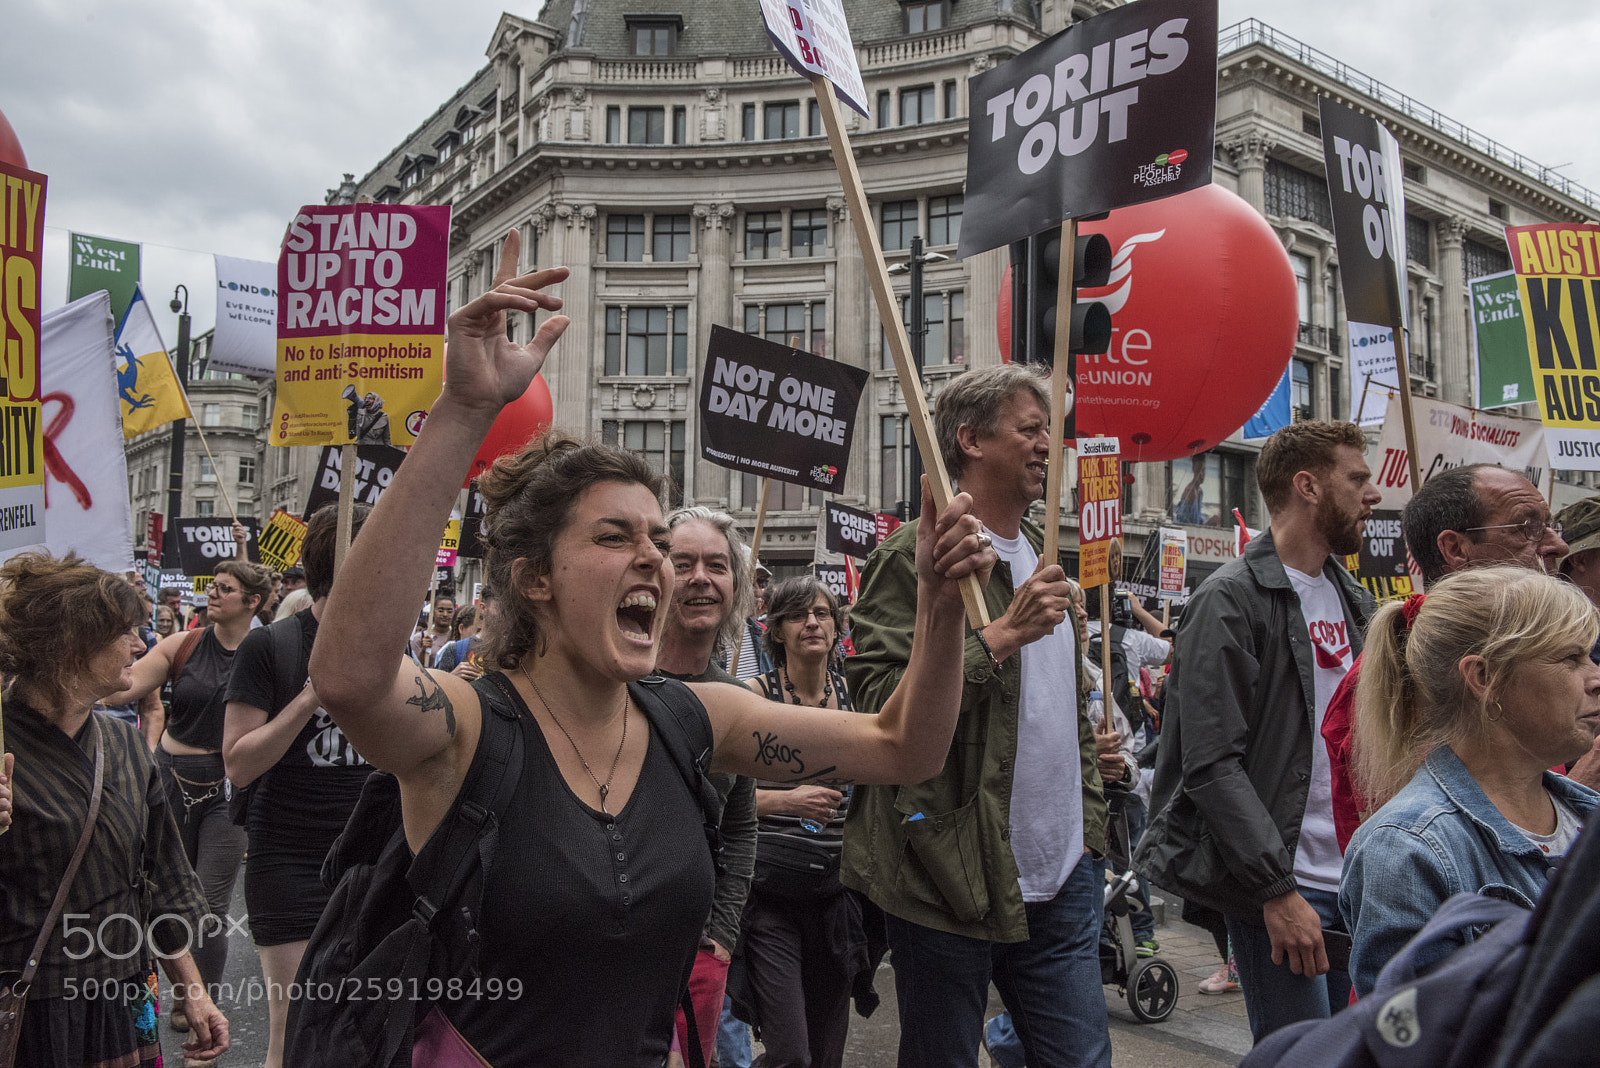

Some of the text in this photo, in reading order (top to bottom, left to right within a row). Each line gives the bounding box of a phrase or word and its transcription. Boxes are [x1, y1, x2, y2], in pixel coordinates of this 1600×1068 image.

[986, 17, 1189, 142] TORIES
[1017, 86, 1139, 175] OUT
[1138, 162, 1156, 173] THE
[1143, 172, 1181, 188] ASSEMBLY
[287, 212, 417, 252] STAND
[76, 242, 127, 261] West
[76, 253, 122, 272] End.
[287, 250, 403, 291] UP TO
[226, 301, 275, 316] EVERYONE
[286, 288, 436, 330] RACISM
[1478, 304, 1520, 324] End.
[228, 312, 272, 326] WELCOME
[284, 343, 432, 363] No to Islamophobia
[284, 362, 424, 382] and anti-Semitism
[713, 356, 836, 415] NOT ONE
[708, 385, 847, 446] DAY MORE
[1450, 415, 1521, 447] YOUNG SOCIALISTS
[1101, 443, 1116, 453] Worker
[740, 457, 750, 465] NO
[751, 460, 769, 469] MORE
[769, 464, 799, 476] AUSTERITY
[1081, 456, 1118, 477] KICK THE
[1377, 448, 1409, 488] TUC
[1082, 475, 1119, 502] TORIES
[830, 508, 876, 535] TORIES
[1082, 499, 1120, 541] OUT!
[183, 526, 252, 543] TORIS
[841, 526, 868, 545] OUT
[201, 541, 238, 558] OUT
[259, 523, 303, 567] KILLS
[1370, 538, 1394, 557] OUT
